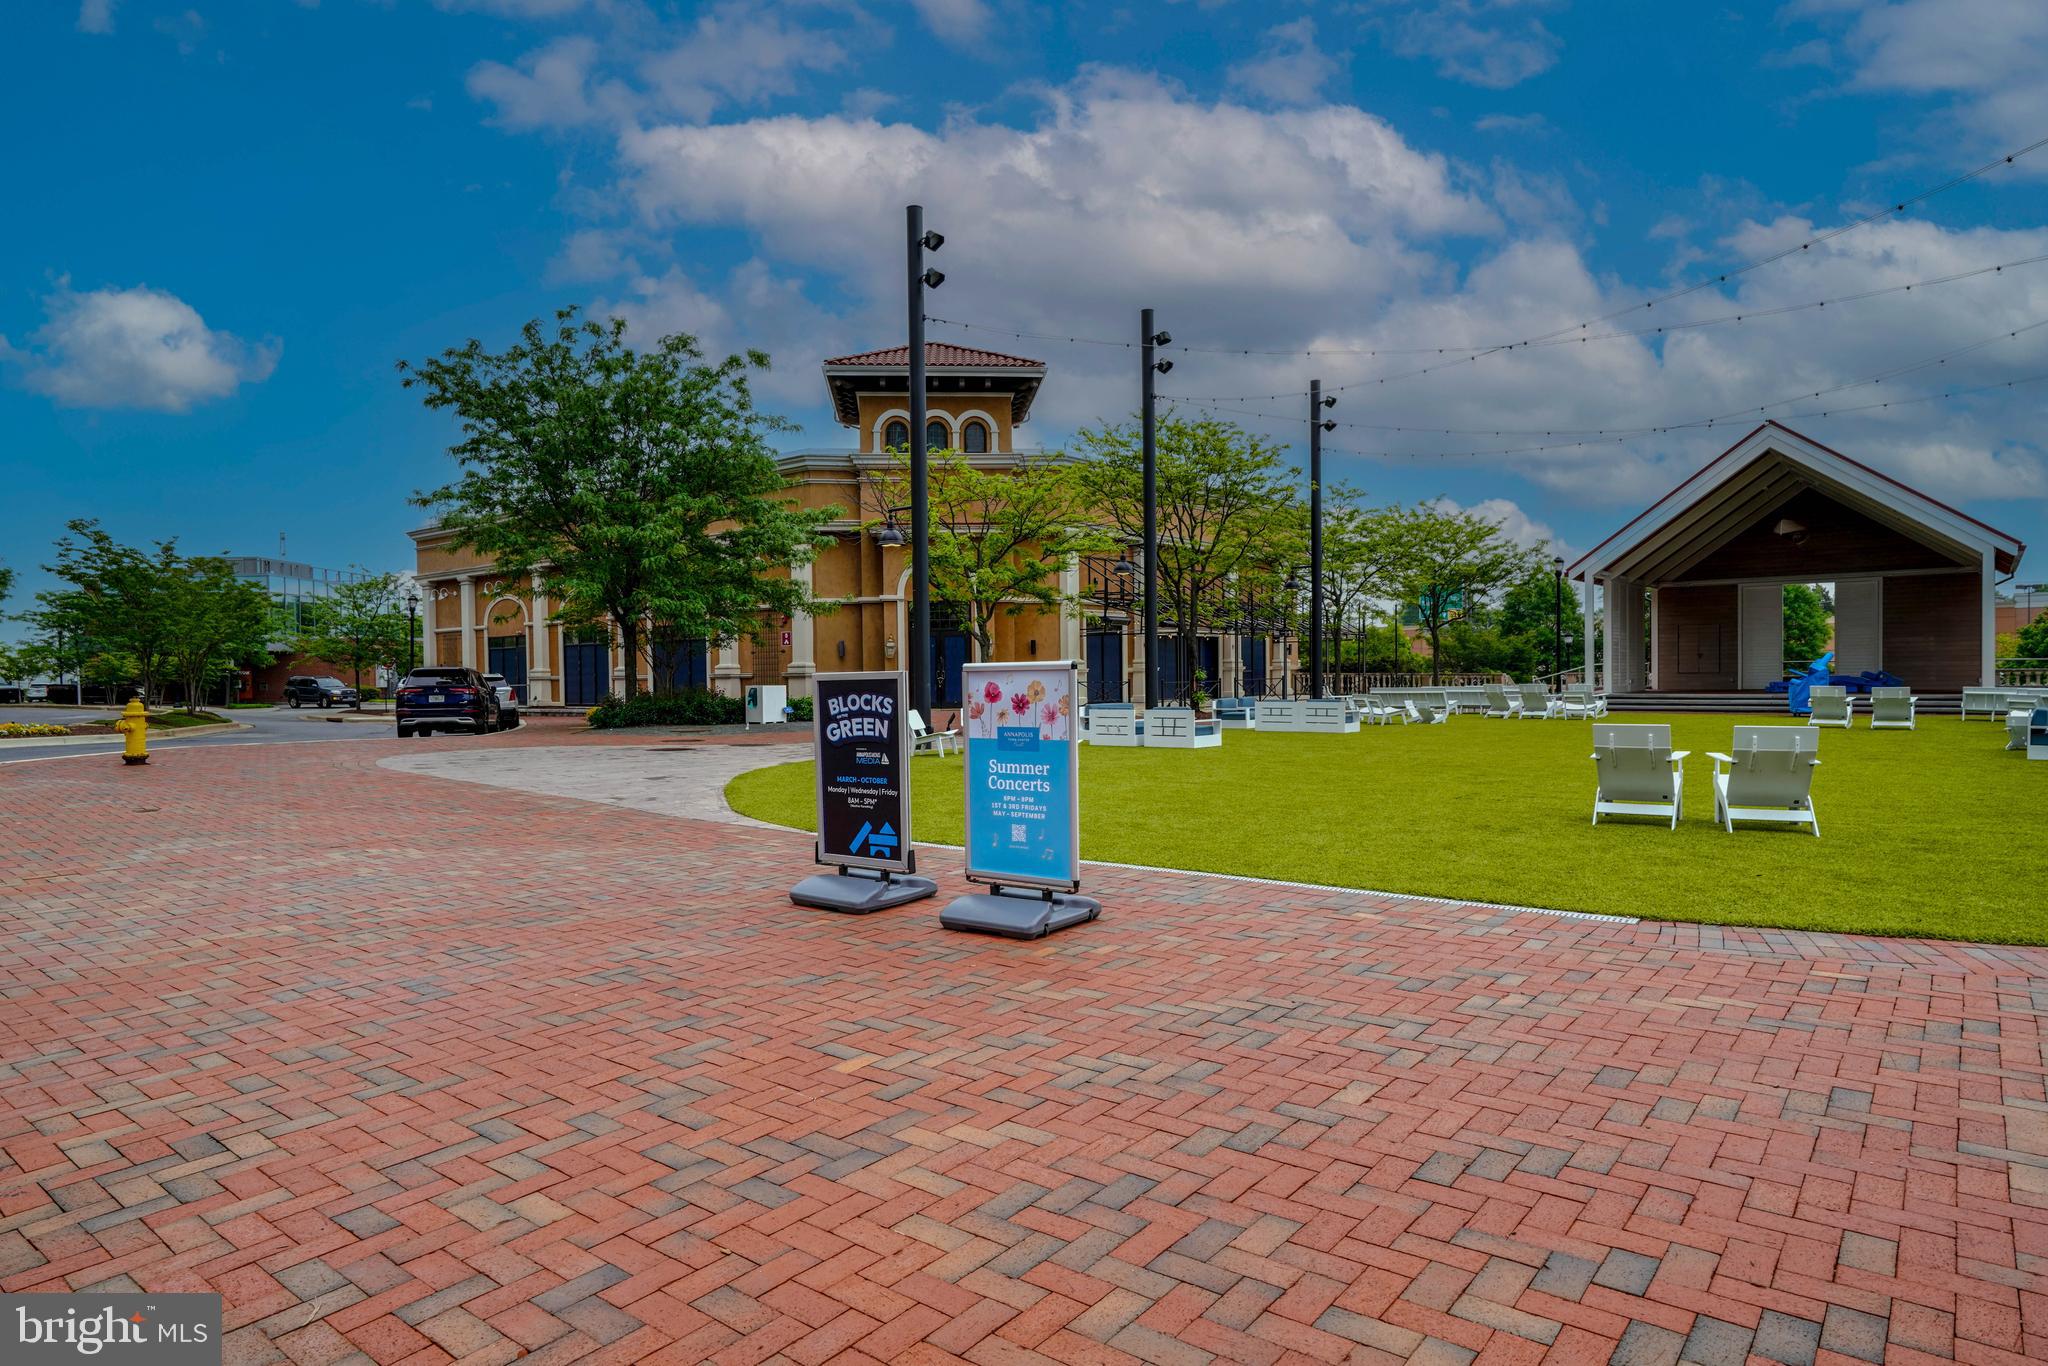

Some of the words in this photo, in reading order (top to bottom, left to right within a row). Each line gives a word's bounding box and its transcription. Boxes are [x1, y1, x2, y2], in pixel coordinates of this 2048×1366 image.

[828, 694, 893, 715] BLOCKS
[826, 717, 889, 742] GREEN
[988, 759, 1050, 776] Summer
[836, 775, 857, 783] MARCH
[860, 776, 888, 784] OCTOBER
[988, 775, 1050, 792] Concerts
[827, 786, 847, 794] Monday
[850, 787, 878, 795] Wednesday
[881, 788, 898, 797] Friday
[1010, 811, 1046, 820] SEPTEMBER
